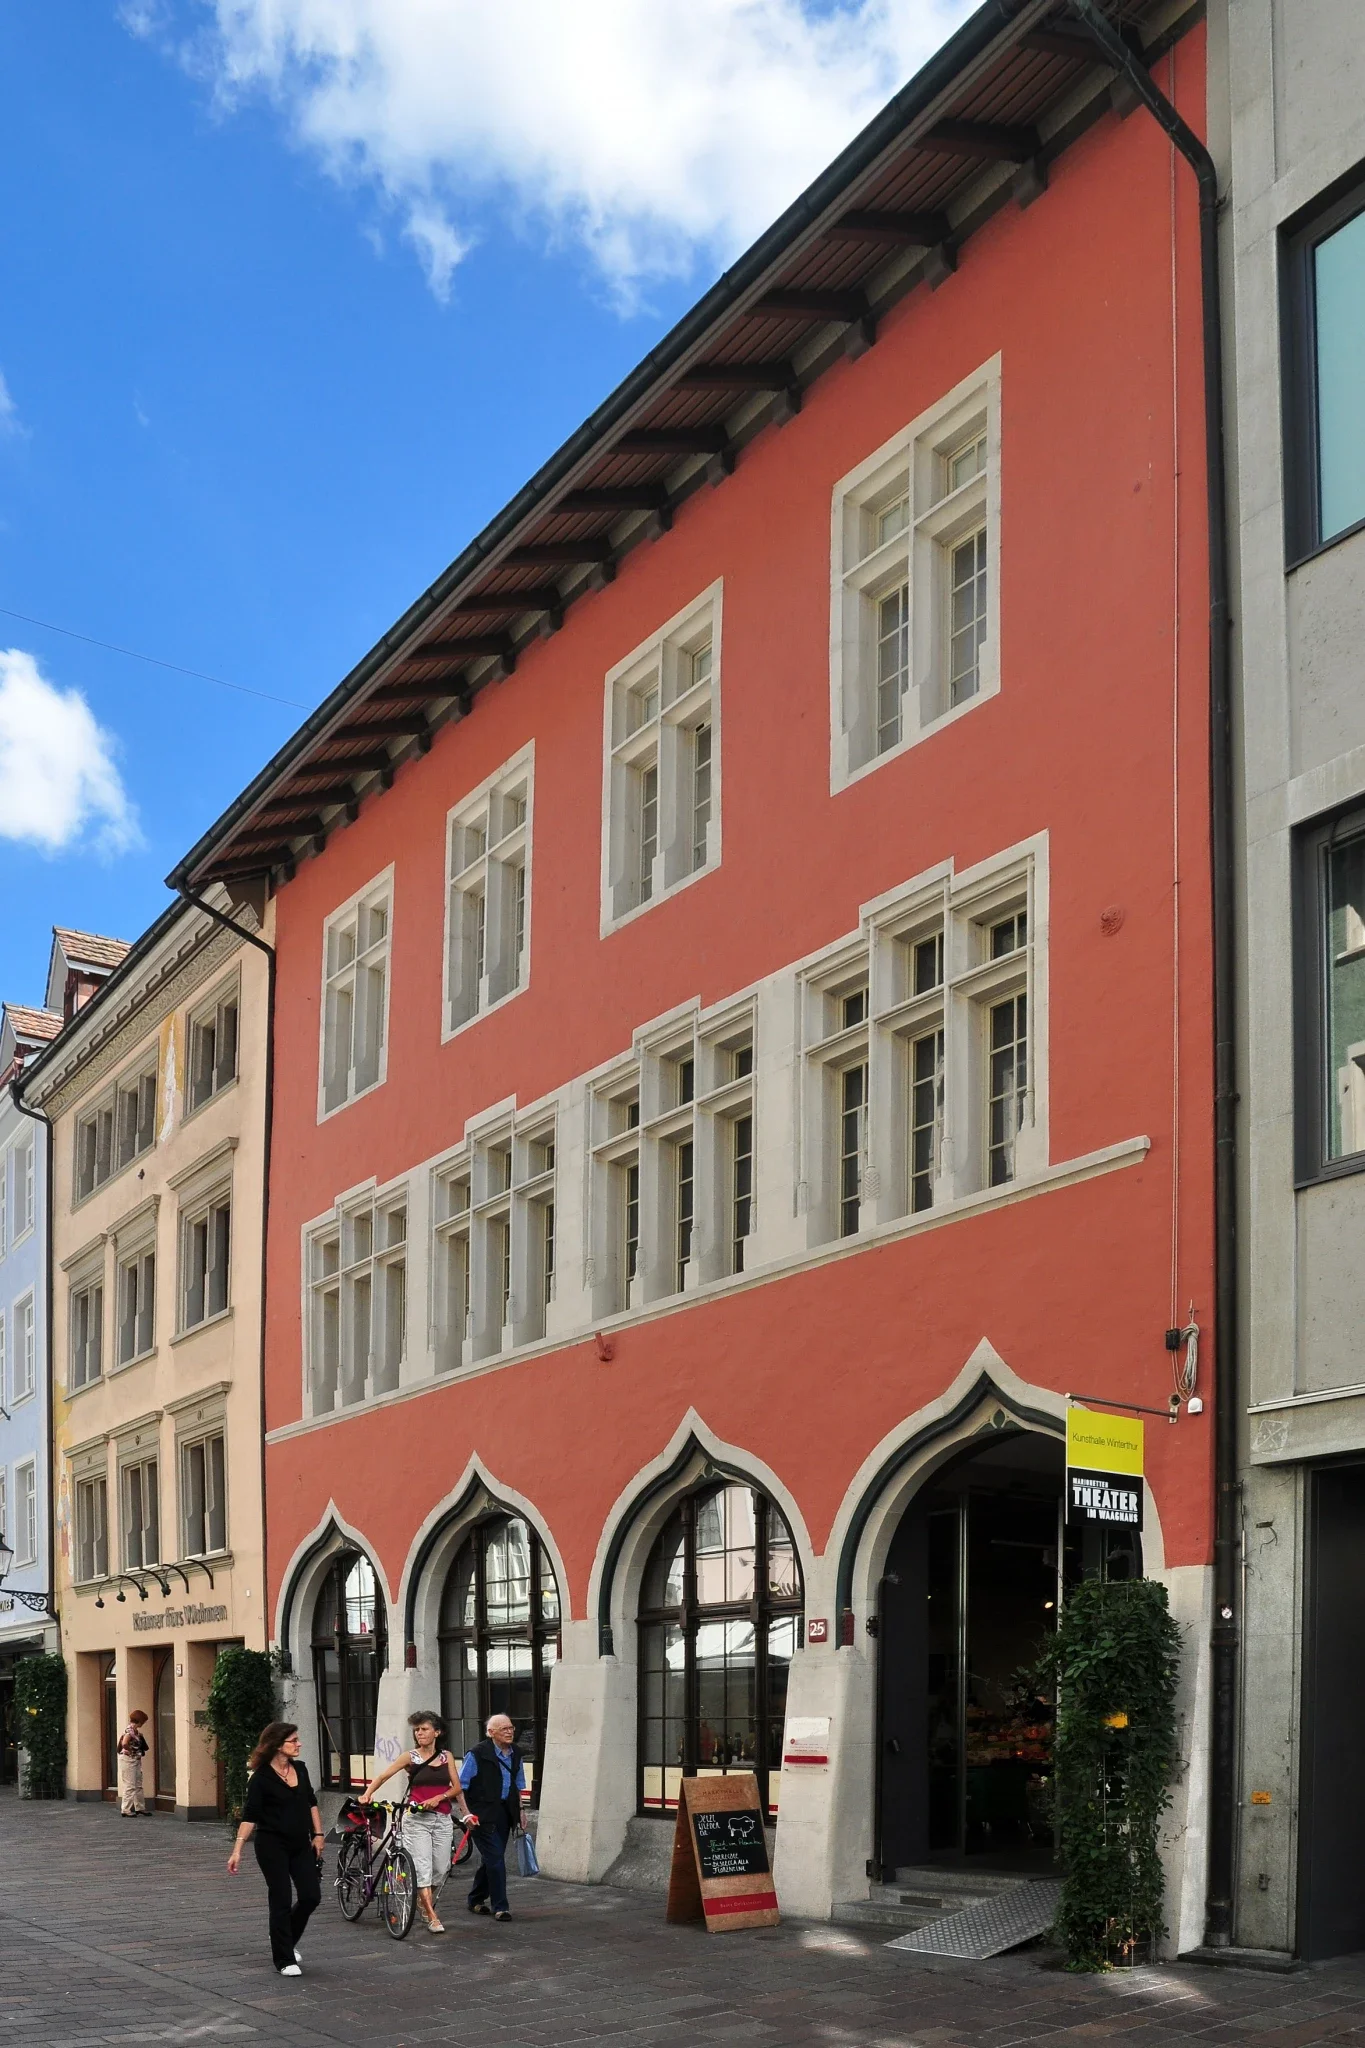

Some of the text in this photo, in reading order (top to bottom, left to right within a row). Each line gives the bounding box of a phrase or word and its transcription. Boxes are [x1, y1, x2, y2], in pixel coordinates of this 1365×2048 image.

[1072, 1432, 1138, 1450] Kunsthalle Winterthur
[1072, 1486, 1138, 1512] THEATER
[1086, 1508, 1138, 1523] IM WAAGHAUS
[182, 1602, 228, 1626] Wohnen
[810, 1621, 825, 1636] 25
